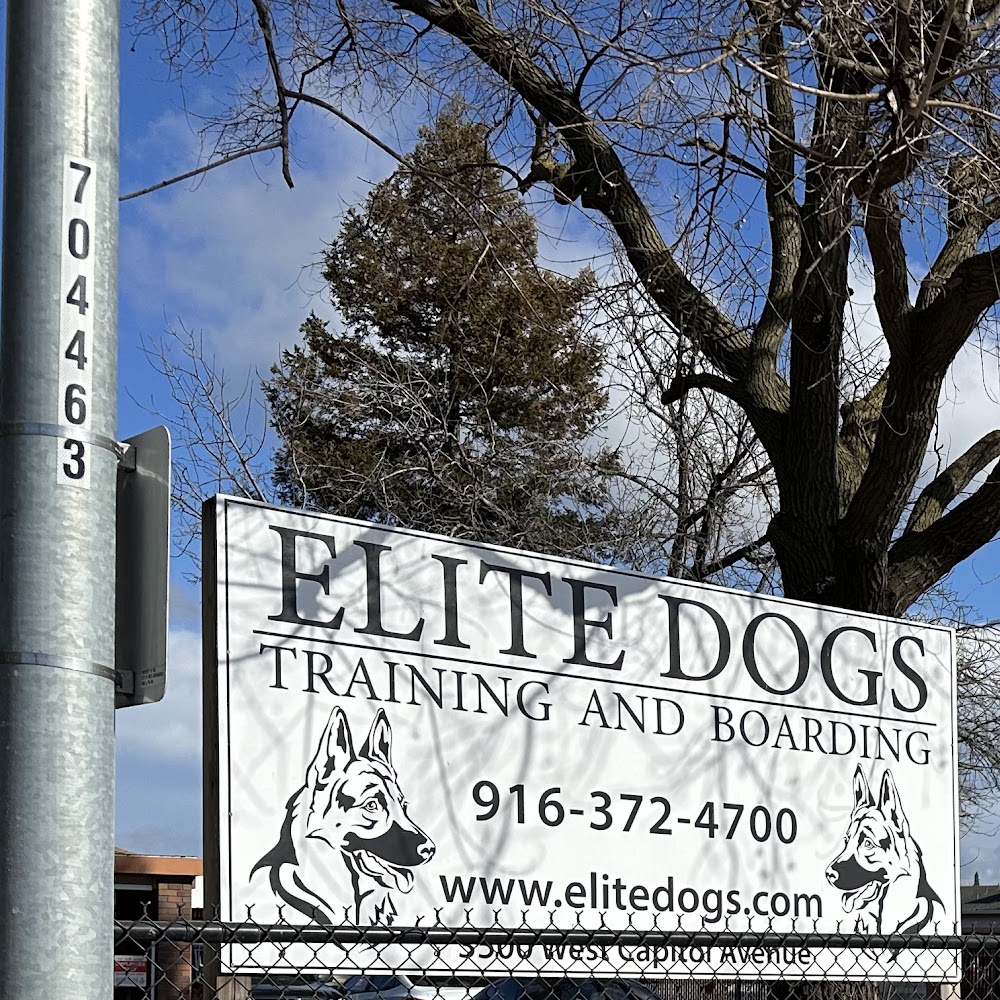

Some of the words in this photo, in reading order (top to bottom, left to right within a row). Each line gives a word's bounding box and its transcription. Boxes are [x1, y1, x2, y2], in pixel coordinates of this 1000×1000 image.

[63, 161, 92, 481] 704463
[266, 524, 626, 671] ELITE
[657, 593, 929, 714] DOGS
[259, 643, 553, 723] TRAINING
[579, 687, 686, 737] AND
[710, 710, 931, 766] BOARDING
[472, 779, 798, 845] 916-372-4700
[439, 871, 824, 924] www.elitedogs.com
